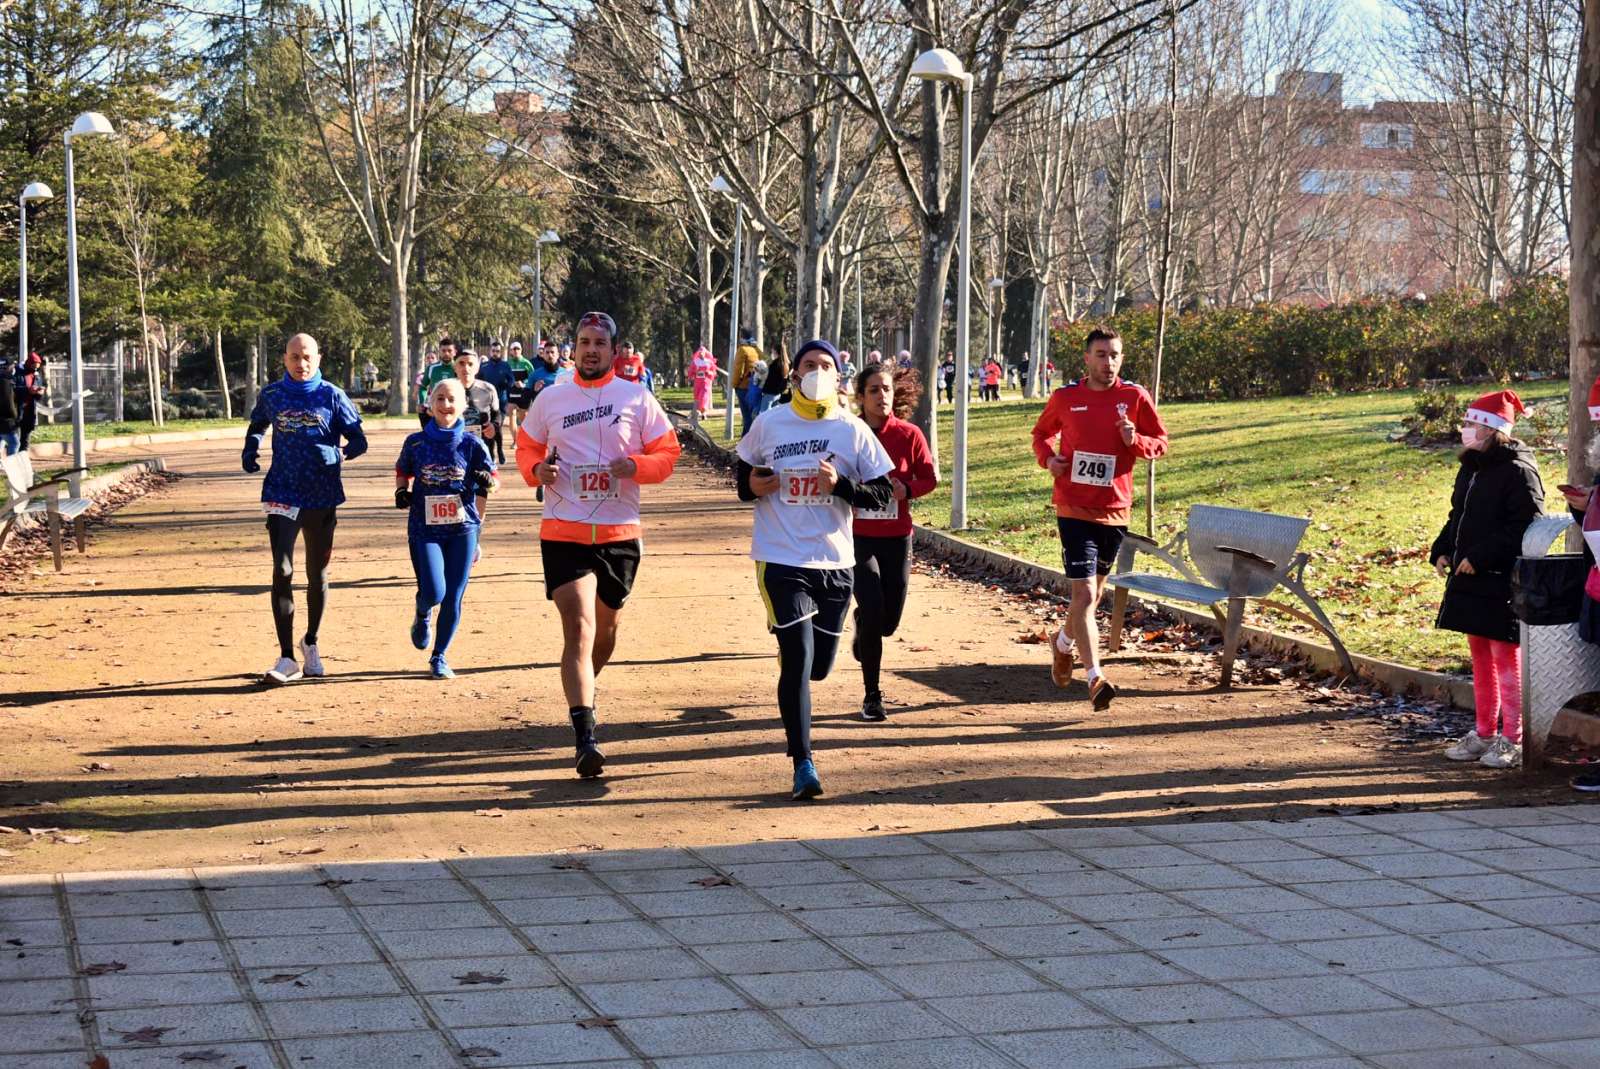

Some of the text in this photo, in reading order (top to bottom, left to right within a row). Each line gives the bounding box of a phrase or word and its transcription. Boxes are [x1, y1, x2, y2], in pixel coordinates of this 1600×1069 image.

[563, 404, 613, 429] ESBIRROS TEAM
[774, 439, 830, 460] ESBIRROS TEAM
[1078, 460, 1106, 479] 249
[579, 472, 609, 491] 126
[790, 476, 820, 496] 372
[432, 502, 457, 517] 169
